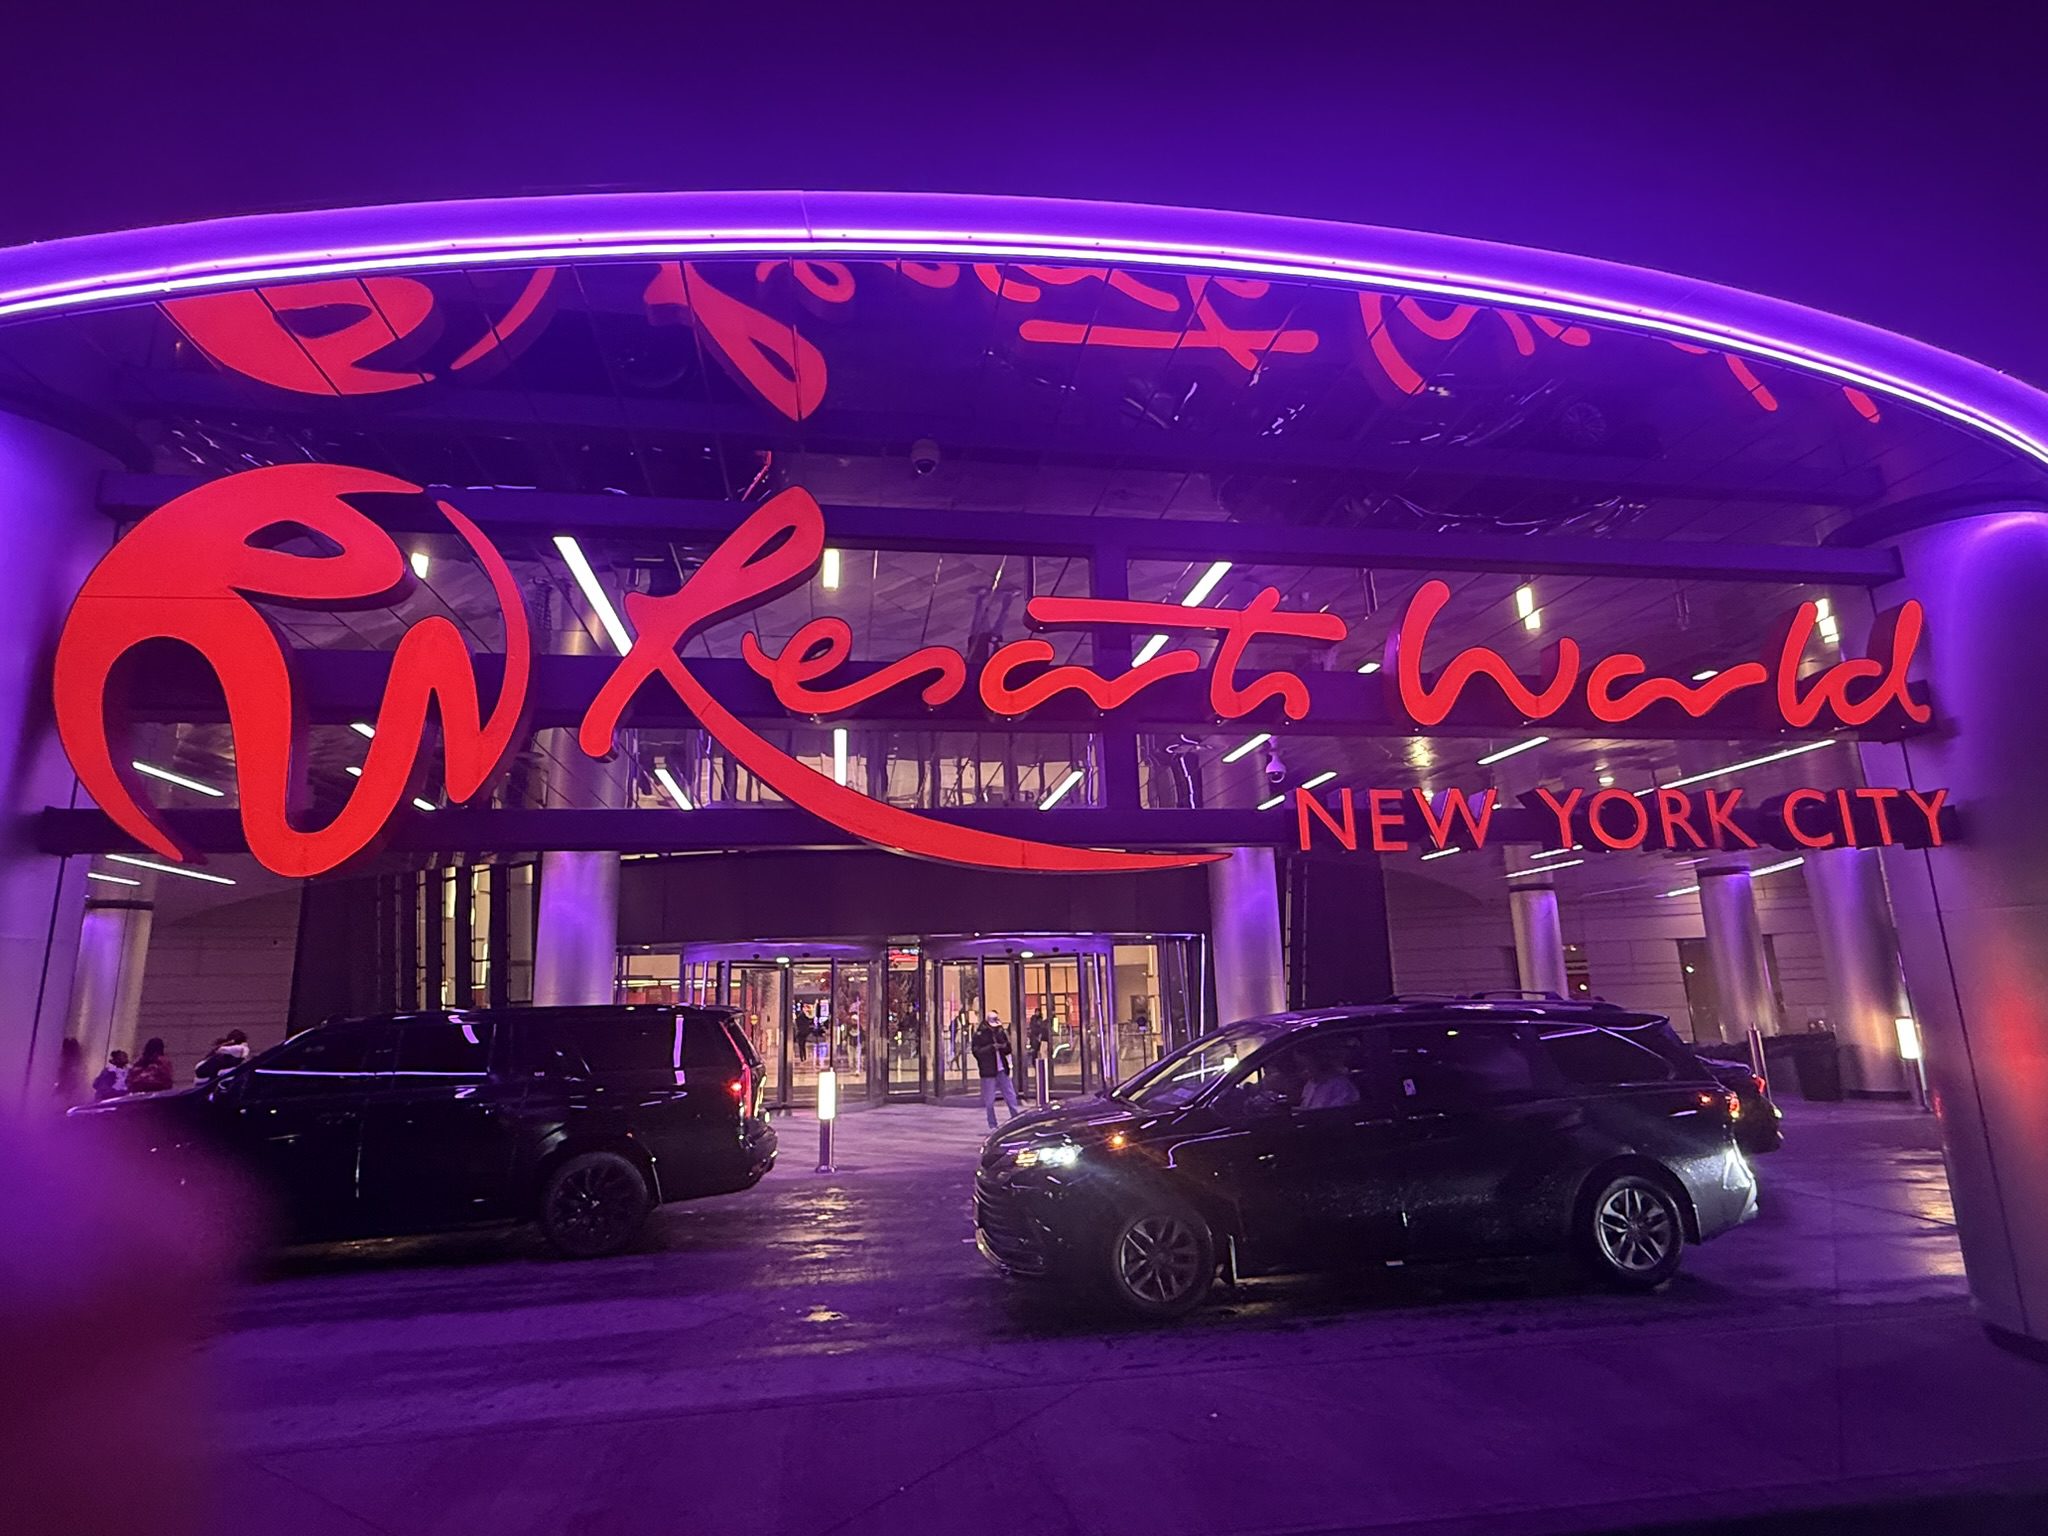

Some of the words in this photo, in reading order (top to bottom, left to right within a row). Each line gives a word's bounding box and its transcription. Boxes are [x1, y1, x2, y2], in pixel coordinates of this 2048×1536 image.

[1398, 579, 1932, 727] World
[1294, 787, 1498, 851] NEW
[1536, 788, 1757, 850] YORK
[1782, 788, 1948, 849] CITY
